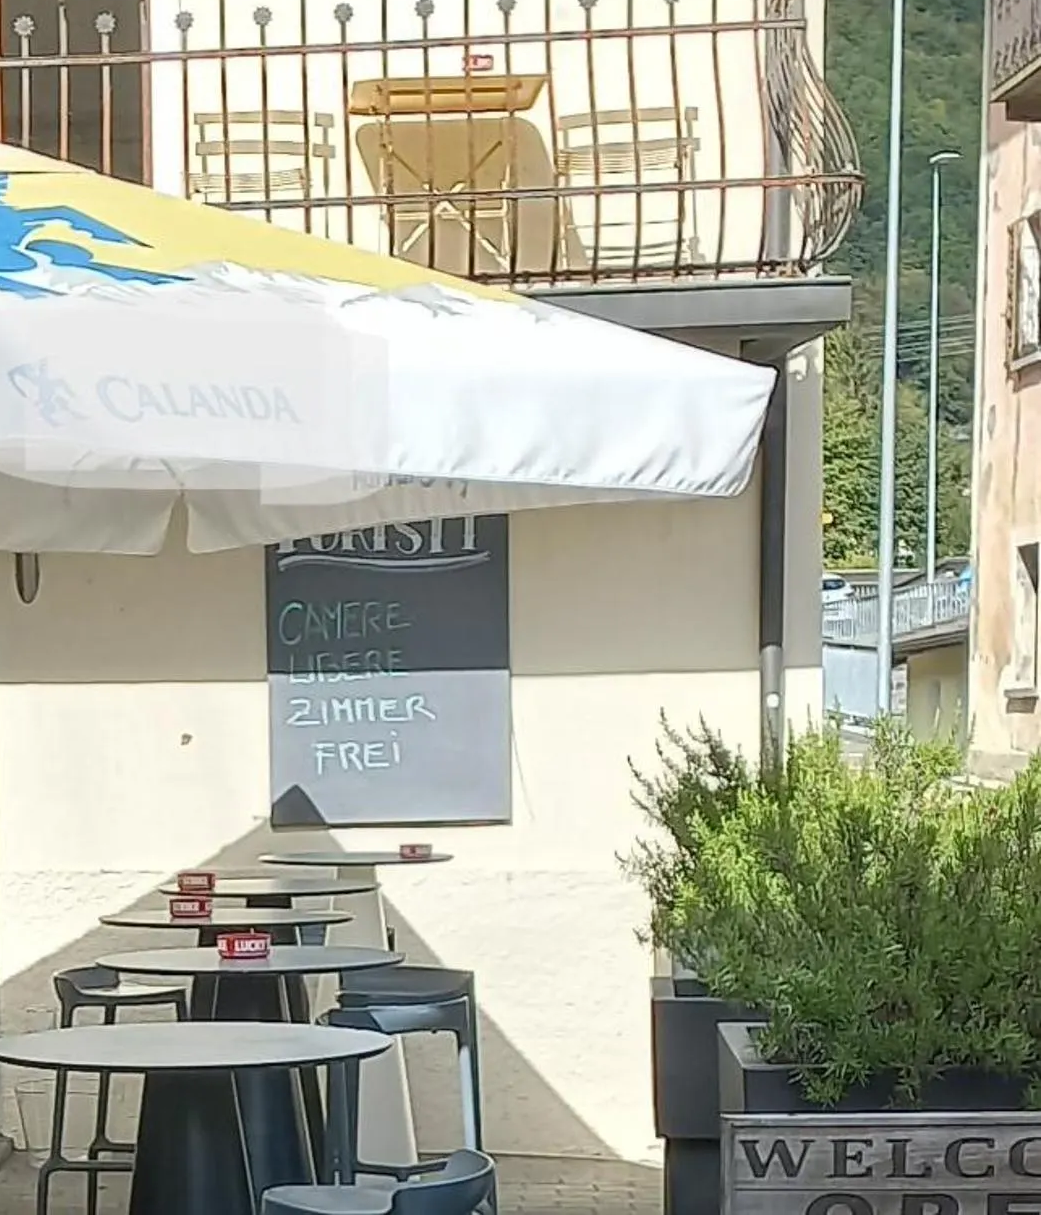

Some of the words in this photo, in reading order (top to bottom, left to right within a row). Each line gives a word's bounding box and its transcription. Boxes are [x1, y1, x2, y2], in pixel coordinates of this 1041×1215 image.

[96, 374, 304, 425] CALANDA
[277, 516, 478, 555] ISTI
[278, 601, 411, 646] CAMERE
[289, 649, 410, 684] LIBERE
[286, 694, 437, 727] ZIMMER
